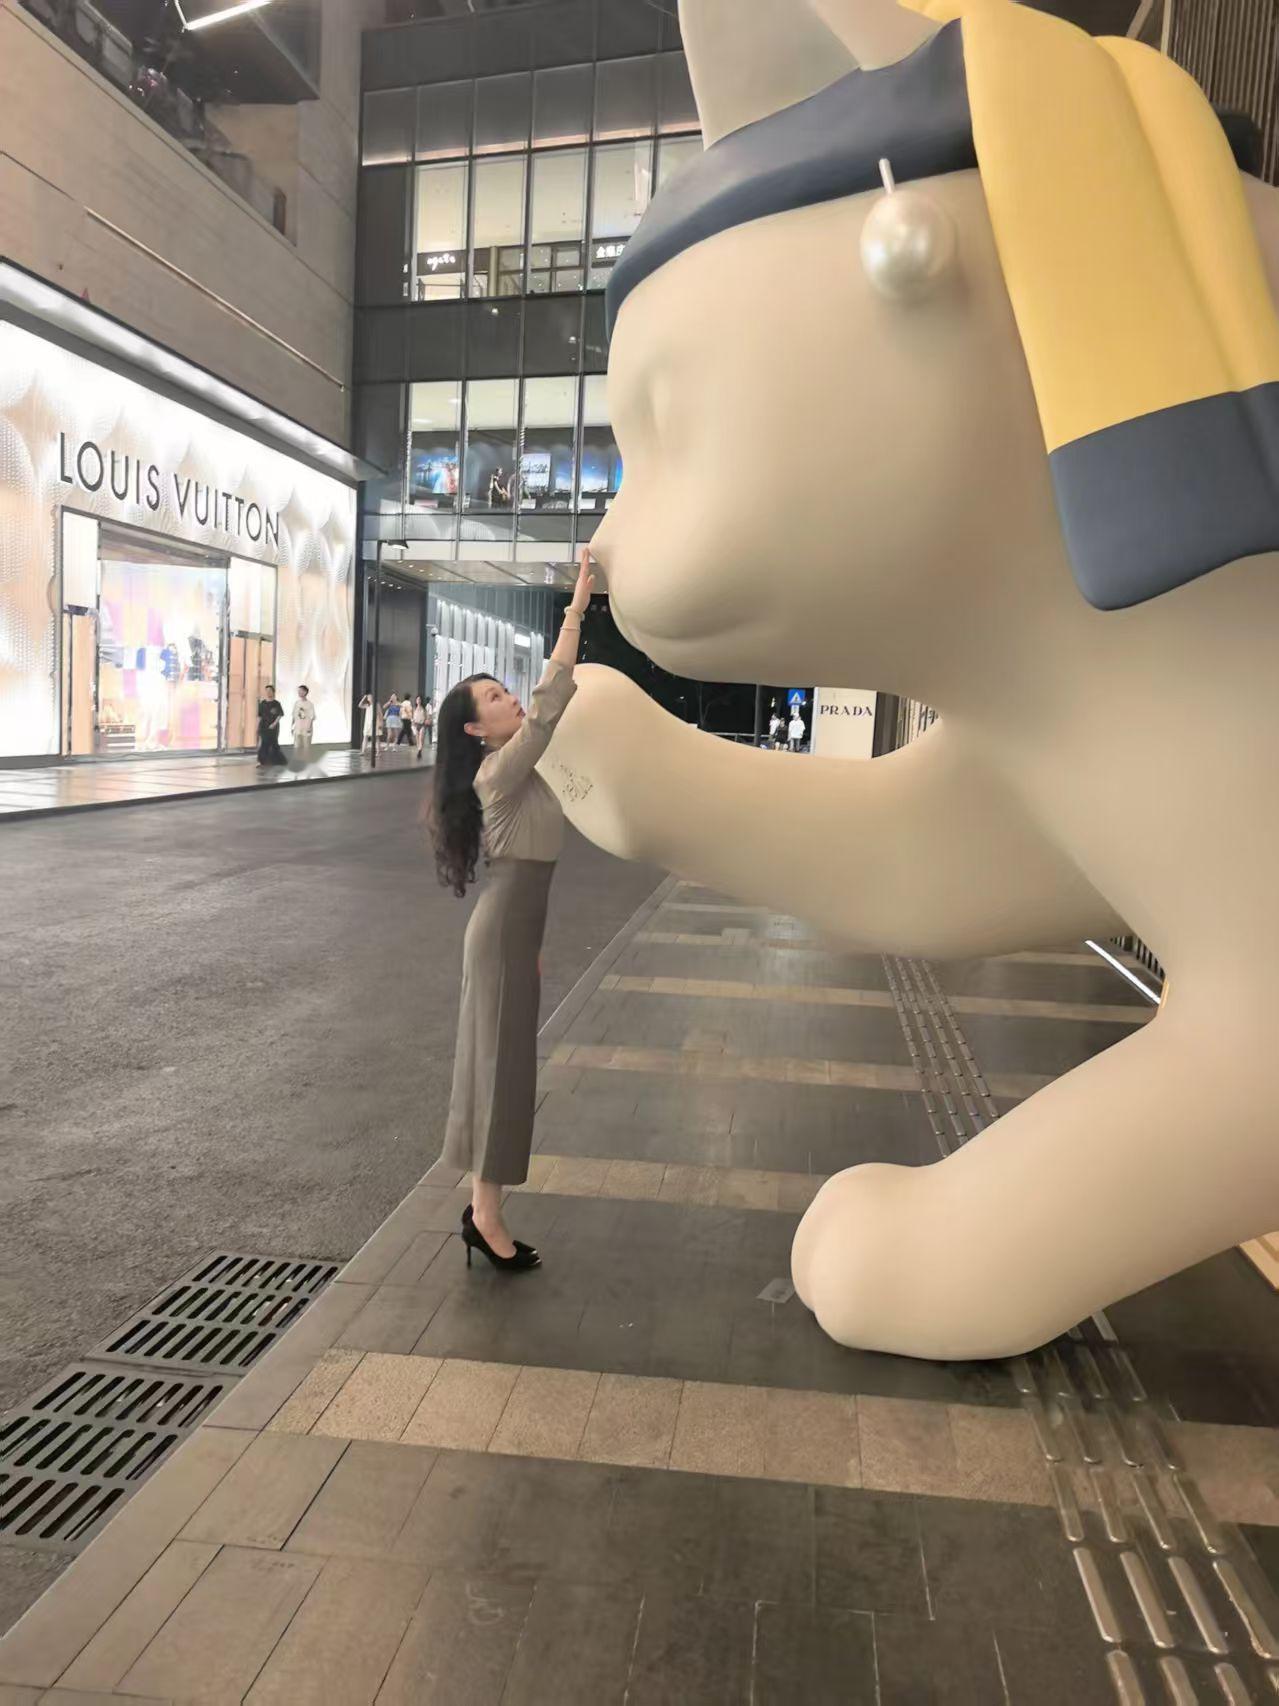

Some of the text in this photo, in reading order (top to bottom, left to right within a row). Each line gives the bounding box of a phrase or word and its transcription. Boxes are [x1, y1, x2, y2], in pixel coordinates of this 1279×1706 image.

[60, 432, 279, 547] LOUIS VUITTON
[820, 704, 873, 717] PRADA
